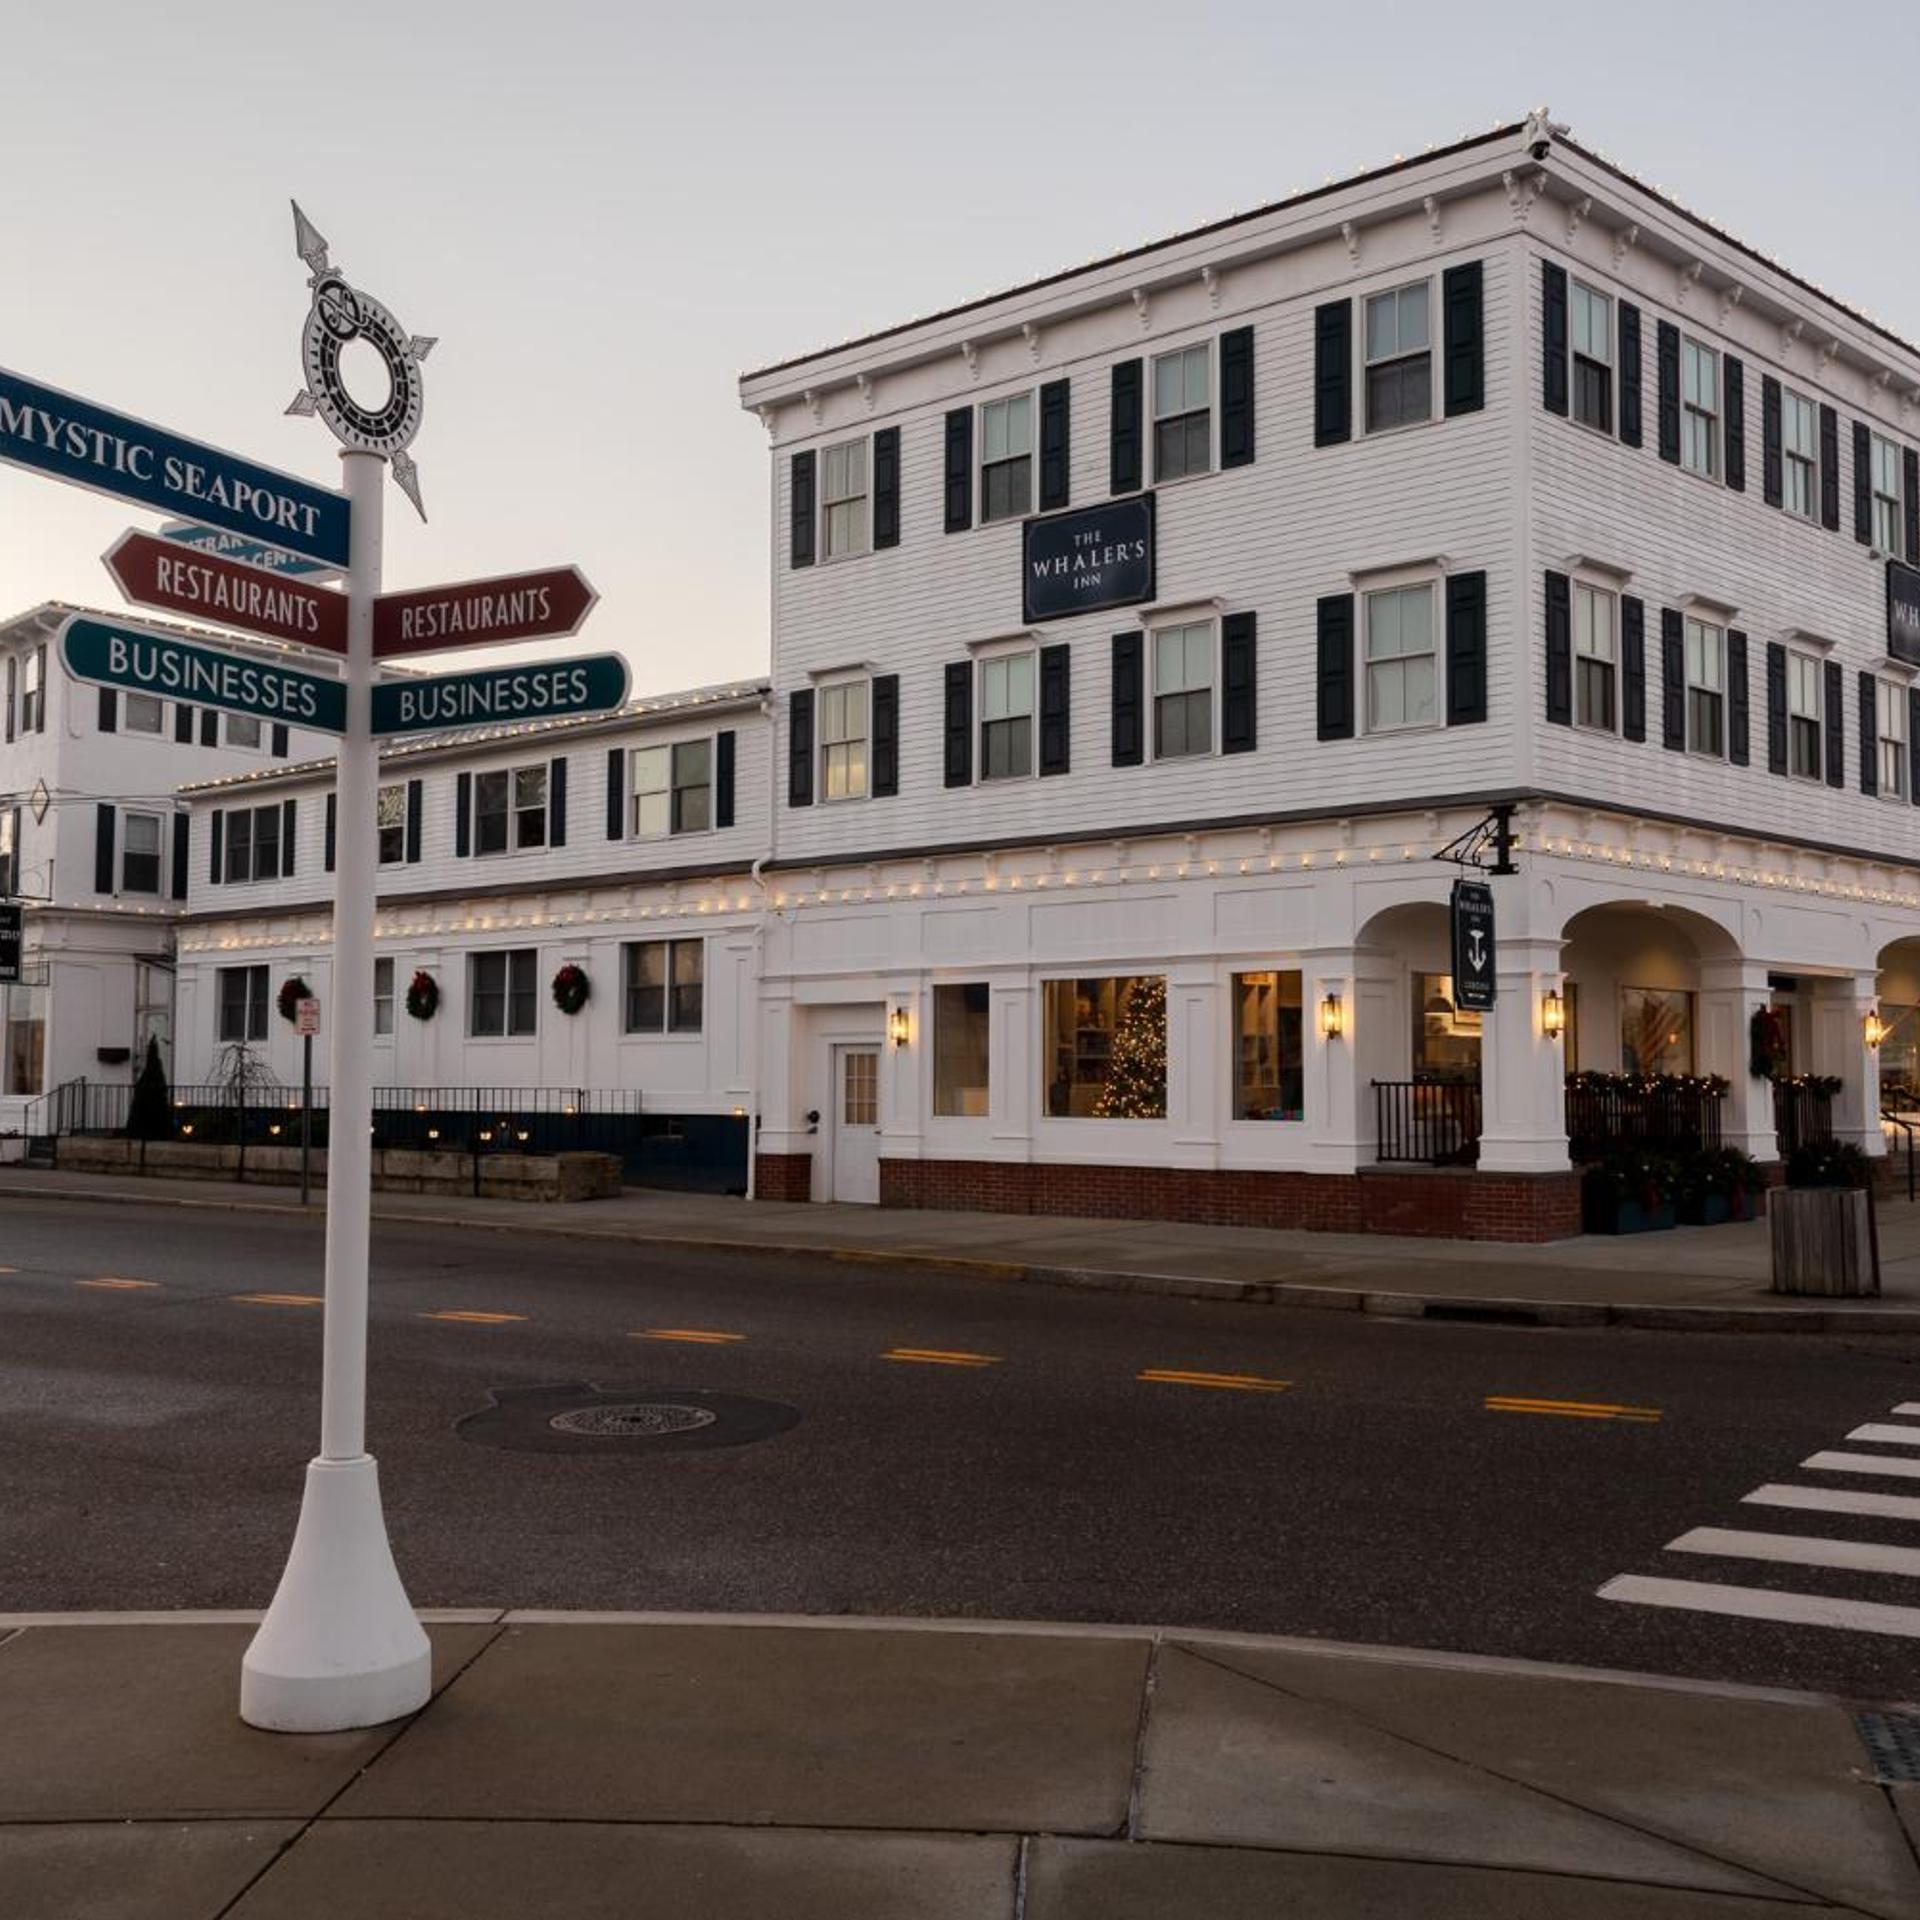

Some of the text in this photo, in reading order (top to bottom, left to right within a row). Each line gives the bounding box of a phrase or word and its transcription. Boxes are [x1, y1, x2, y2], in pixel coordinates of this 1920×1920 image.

[0, 397, 320, 537] MYSTIC SEAPORT
[1033, 540, 1145, 578] WHALER'S
[1073, 530, 1102, 547] THE
[157, 556, 319, 632] RESTAURANTS
[1073, 573, 1102, 590] INN
[402, 587, 552, 640] RESTAURANTS
[110, 637, 317, 717] BUSINESSES
[401, 669, 588, 721] BUSINESSES
